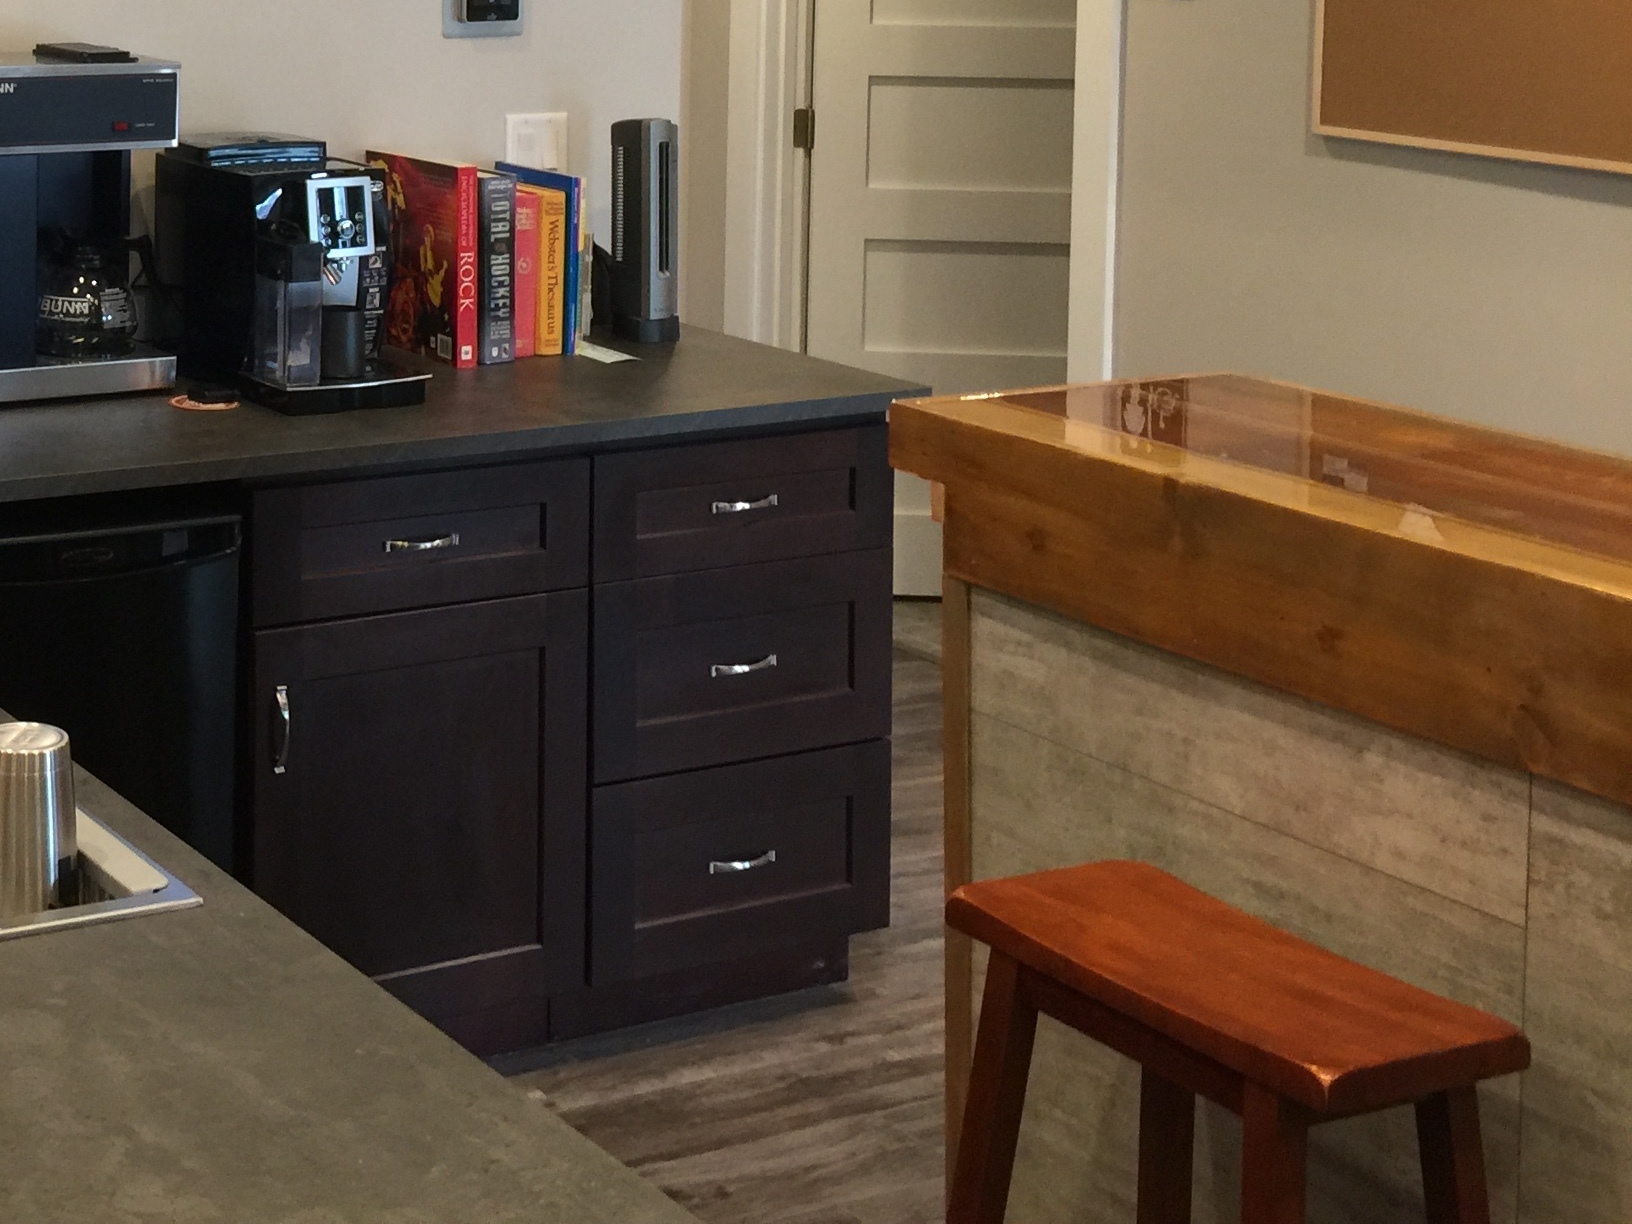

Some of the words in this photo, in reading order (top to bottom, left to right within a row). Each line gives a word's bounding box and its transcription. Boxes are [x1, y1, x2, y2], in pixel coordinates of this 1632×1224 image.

[490, 192, 511, 243] TOTAL
[547, 218, 560, 273] Webster's
[459, 251, 475, 313] ROCK
[489, 253, 510, 318] HOCKEY
[546, 271, 560, 336] Thesaurus
